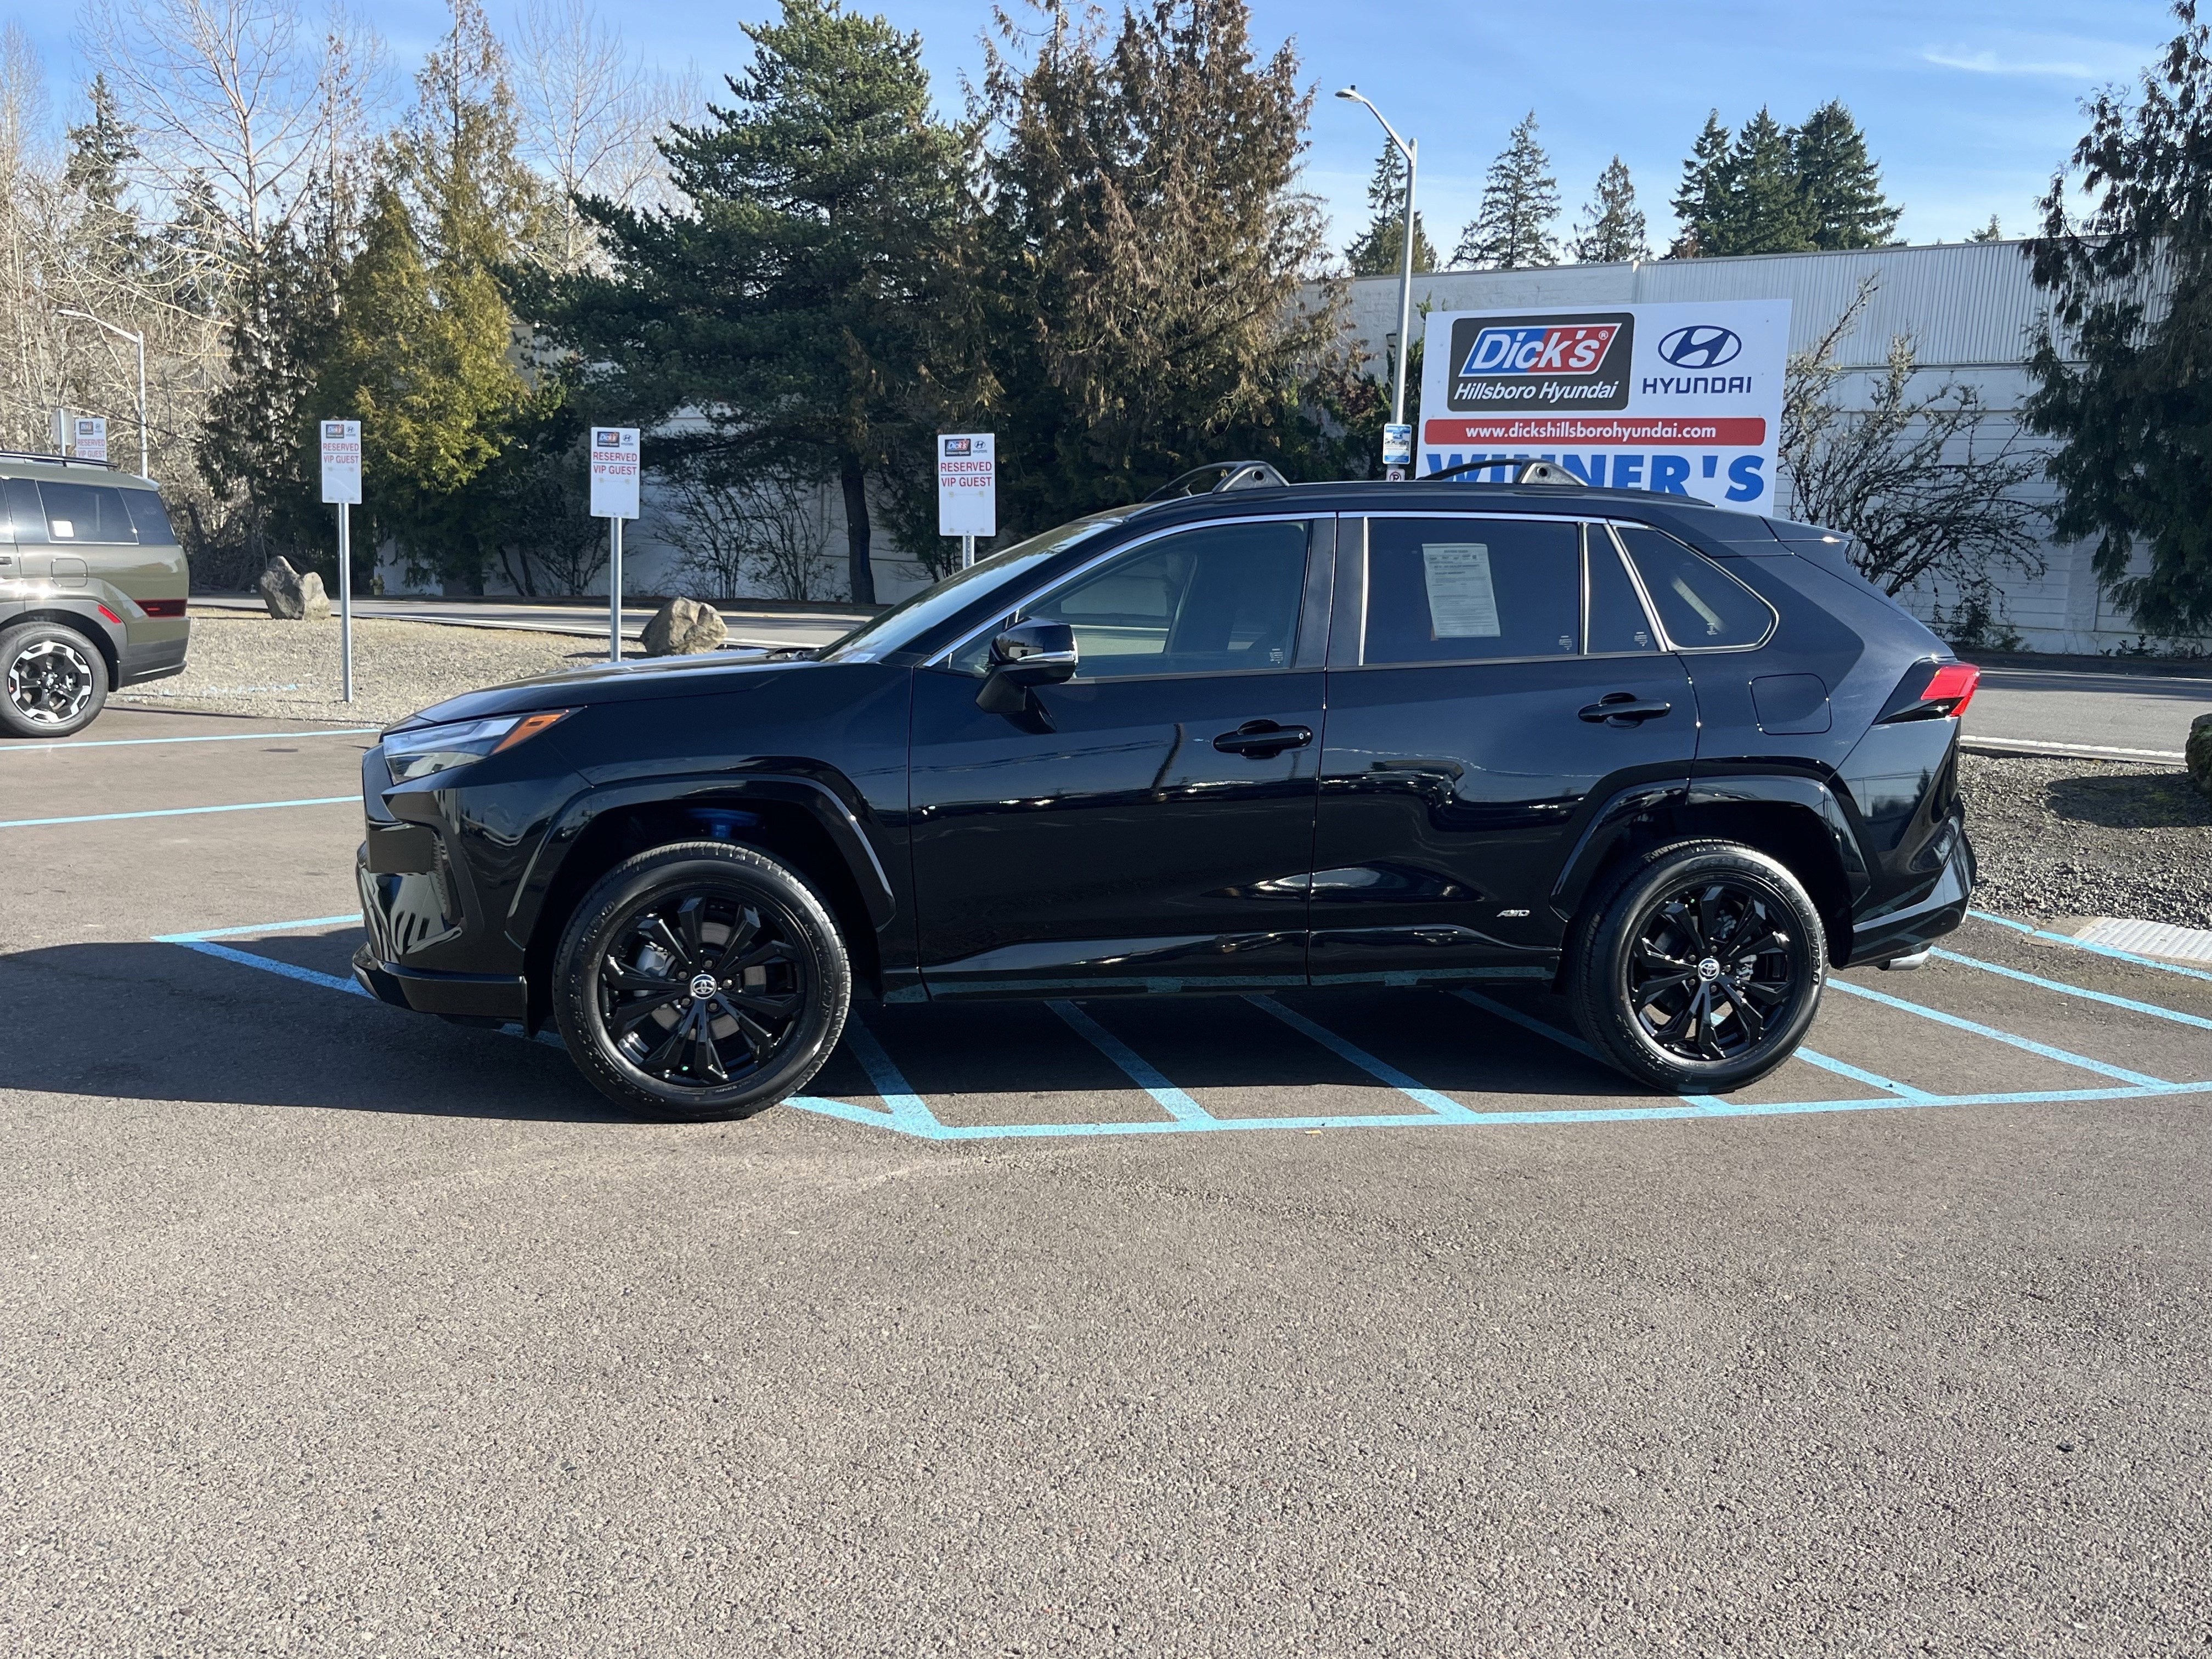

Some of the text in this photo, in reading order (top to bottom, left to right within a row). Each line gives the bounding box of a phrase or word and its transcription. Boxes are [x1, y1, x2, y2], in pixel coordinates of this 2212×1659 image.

[1642, 376, 1752, 394] HYUNDAI
[1454, 381, 1620, 403] Hillsboro Hyundai
[1465, 422, 1716, 442] www.dickshillsborohyundai.com
[323, 443, 359, 451] RESERVED
[323, 455, 359, 464] VIP GUEST
[593, 452, 637, 462] RESERVED
[593, 465, 637, 475] VIP GUEST
[940, 462, 992, 472] RESERVED
[941, 477, 992, 487] VIP GUEST
